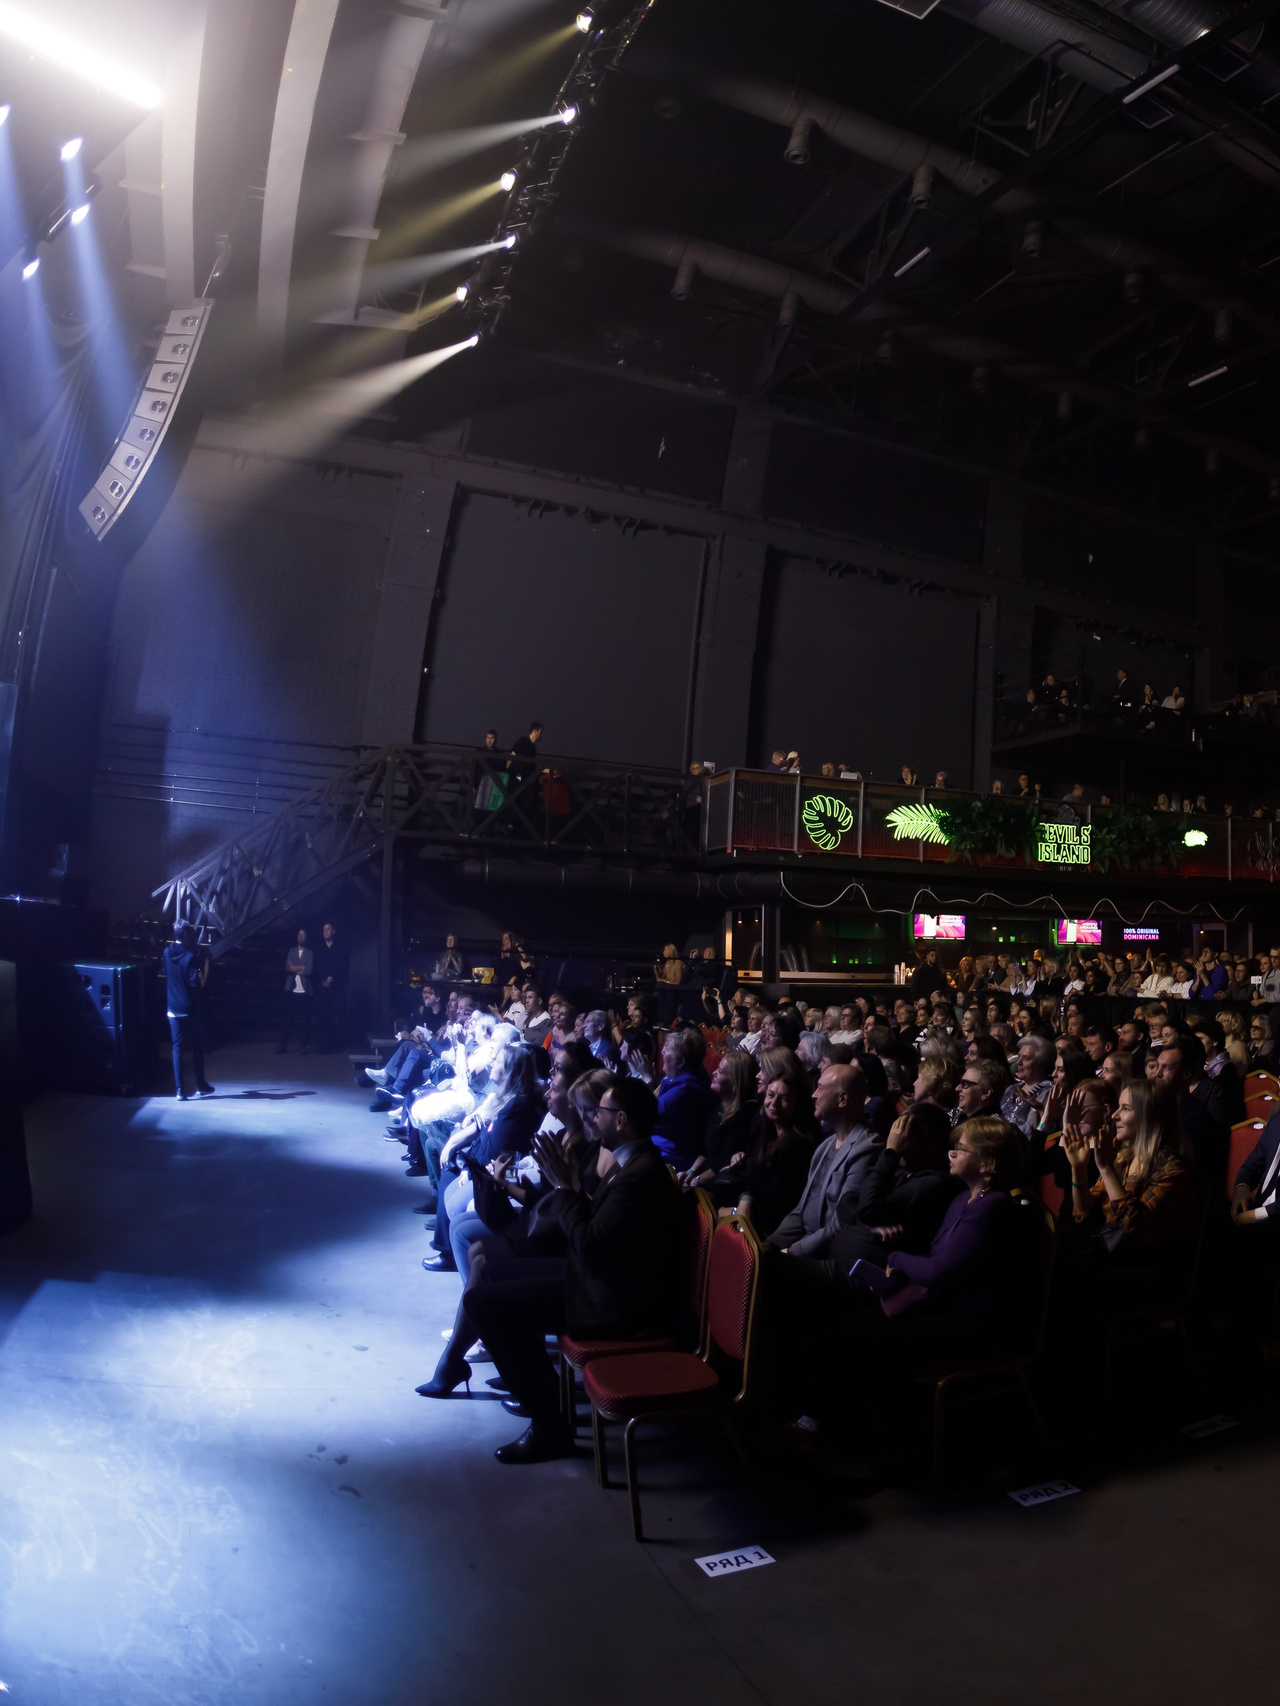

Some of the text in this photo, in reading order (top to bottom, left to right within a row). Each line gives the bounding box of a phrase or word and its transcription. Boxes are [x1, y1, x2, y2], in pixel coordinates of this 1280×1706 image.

[1038, 842, 1091, 864] ISLAND
[1018, 1482, 1074, 1502] РЯД 2
[704, 1550, 768, 1571] РЯД 1
